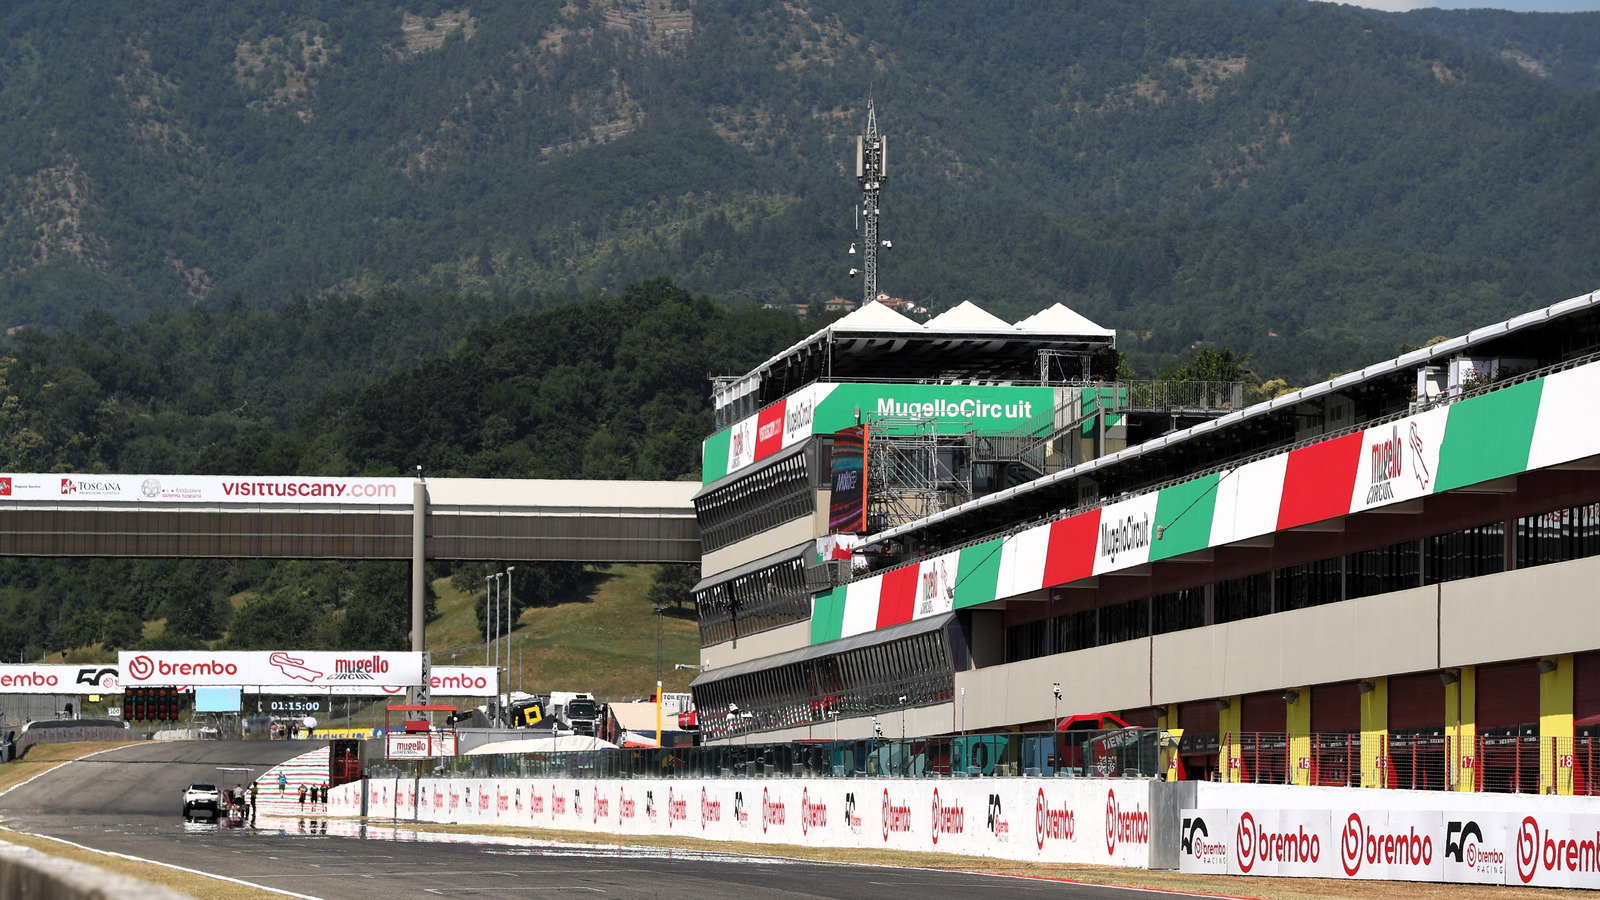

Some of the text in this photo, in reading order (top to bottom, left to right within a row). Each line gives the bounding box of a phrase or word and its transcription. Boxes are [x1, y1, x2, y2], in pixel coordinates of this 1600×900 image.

[877, 398, 1032, 422] MugelloCircuit
[1371, 425, 1402, 484] mugello
[79, 481, 121, 491] TOSCANA
[1366, 481, 1394, 505] CIRCUIT
[1101, 512, 1149, 564] MugelloCircuit
[159, 660, 237, 676] brembo
[335, 655, 389, 674] mugello
[325, 673, 375, 681] CIRCUIT
[271, 701, 319, 711] 01:15:00
[397, 740, 426, 752] mugello
[1231, 758, 1241, 768] 14
[1299, 758, 1310, 768] 15
[1462, 756, 1474, 768] 17
[1560, 755, 1573, 767] 18
[1046, 800, 1074, 839] brembo
[1117, 803, 1149, 844] brembo
[1203, 842, 1225, 855] brembo
[1259, 824, 1320, 863] brembo
[1367, 825, 1432, 865] brembo
[1477, 848, 1504, 864] brembo
[1477, 865, 1503, 874] RACING
